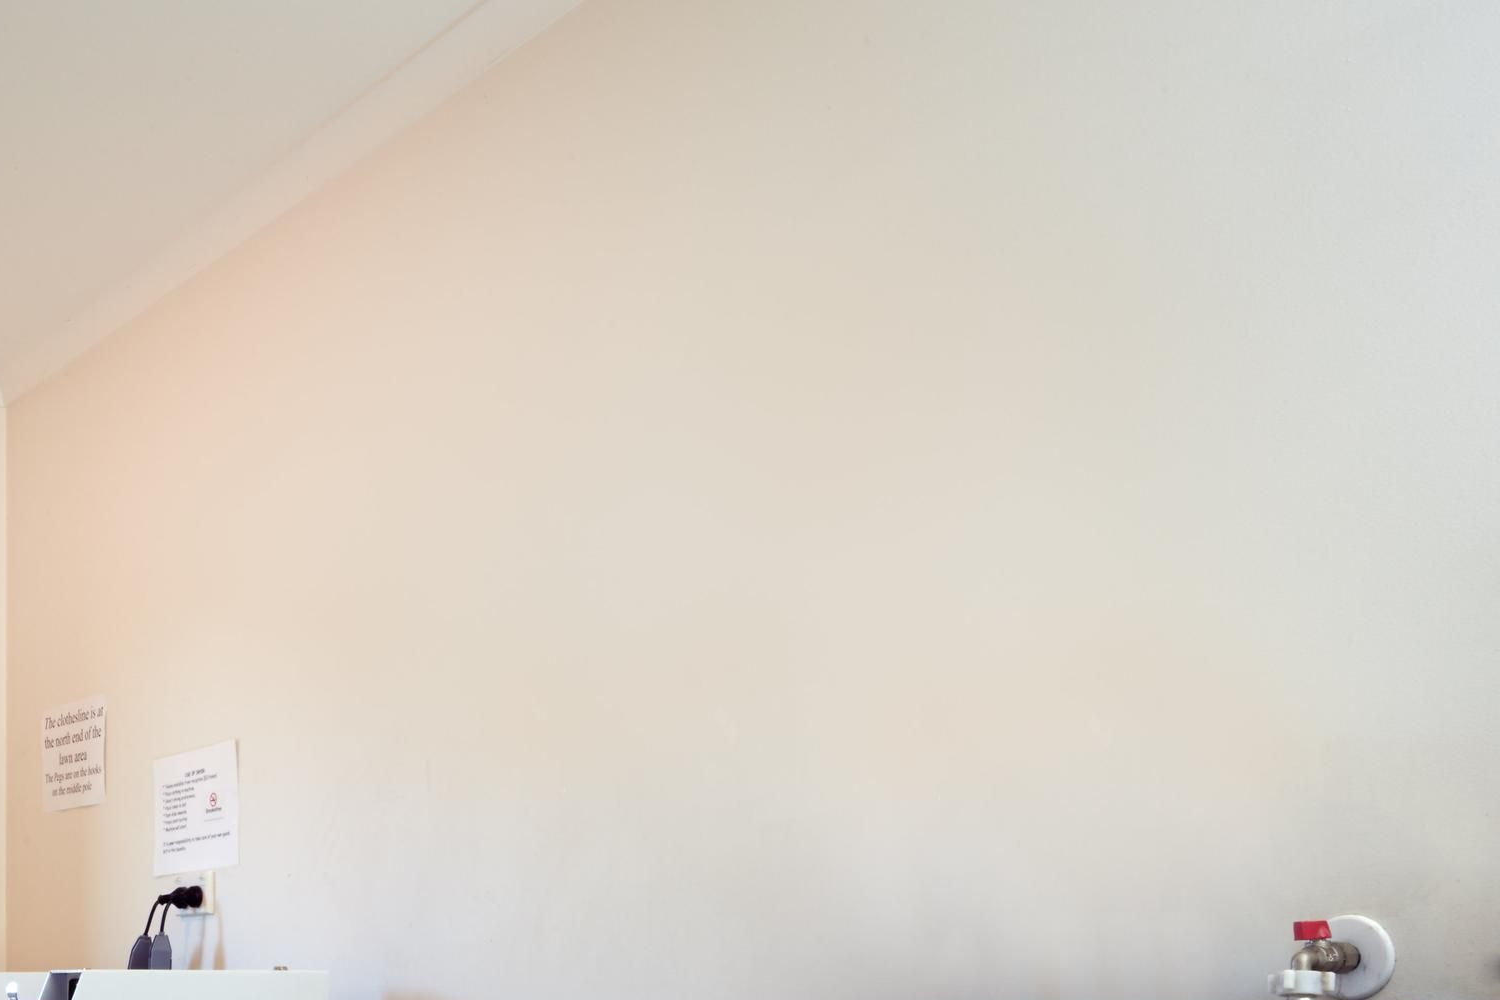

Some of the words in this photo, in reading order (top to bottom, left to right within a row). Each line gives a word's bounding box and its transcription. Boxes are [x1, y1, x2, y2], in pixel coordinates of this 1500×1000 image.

[45, 717, 56, 730] The
[57, 708, 90, 728] clothesline
[44, 736, 54, 749] the
[55, 731, 71, 748] north
[72, 728, 84, 744] end
[84, 726, 92, 741] of
[92, 724, 102, 739] the
[59, 752, 73, 765] lawn
[74, 751, 88, 762] area
